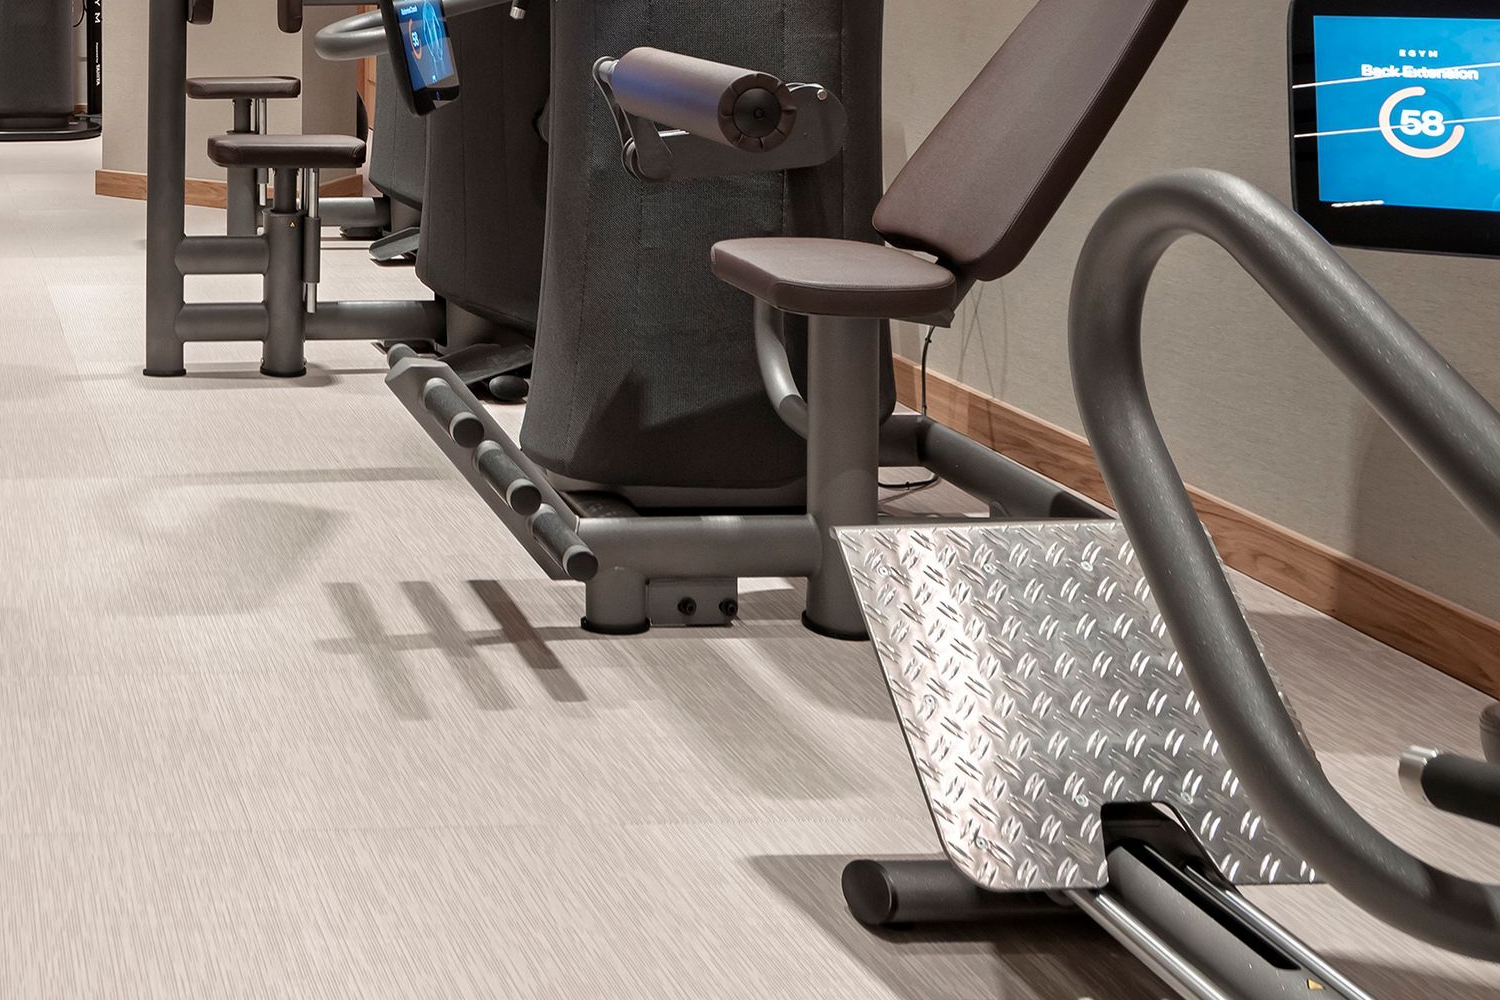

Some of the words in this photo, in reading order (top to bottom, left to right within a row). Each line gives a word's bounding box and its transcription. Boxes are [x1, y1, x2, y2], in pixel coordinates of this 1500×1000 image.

[1398, 49, 1438, 58] EGYM
[1361, 64, 1399, 78] Back
[1402, 65, 1479, 80] Extension
[1400, 109, 1445, 137] 58
